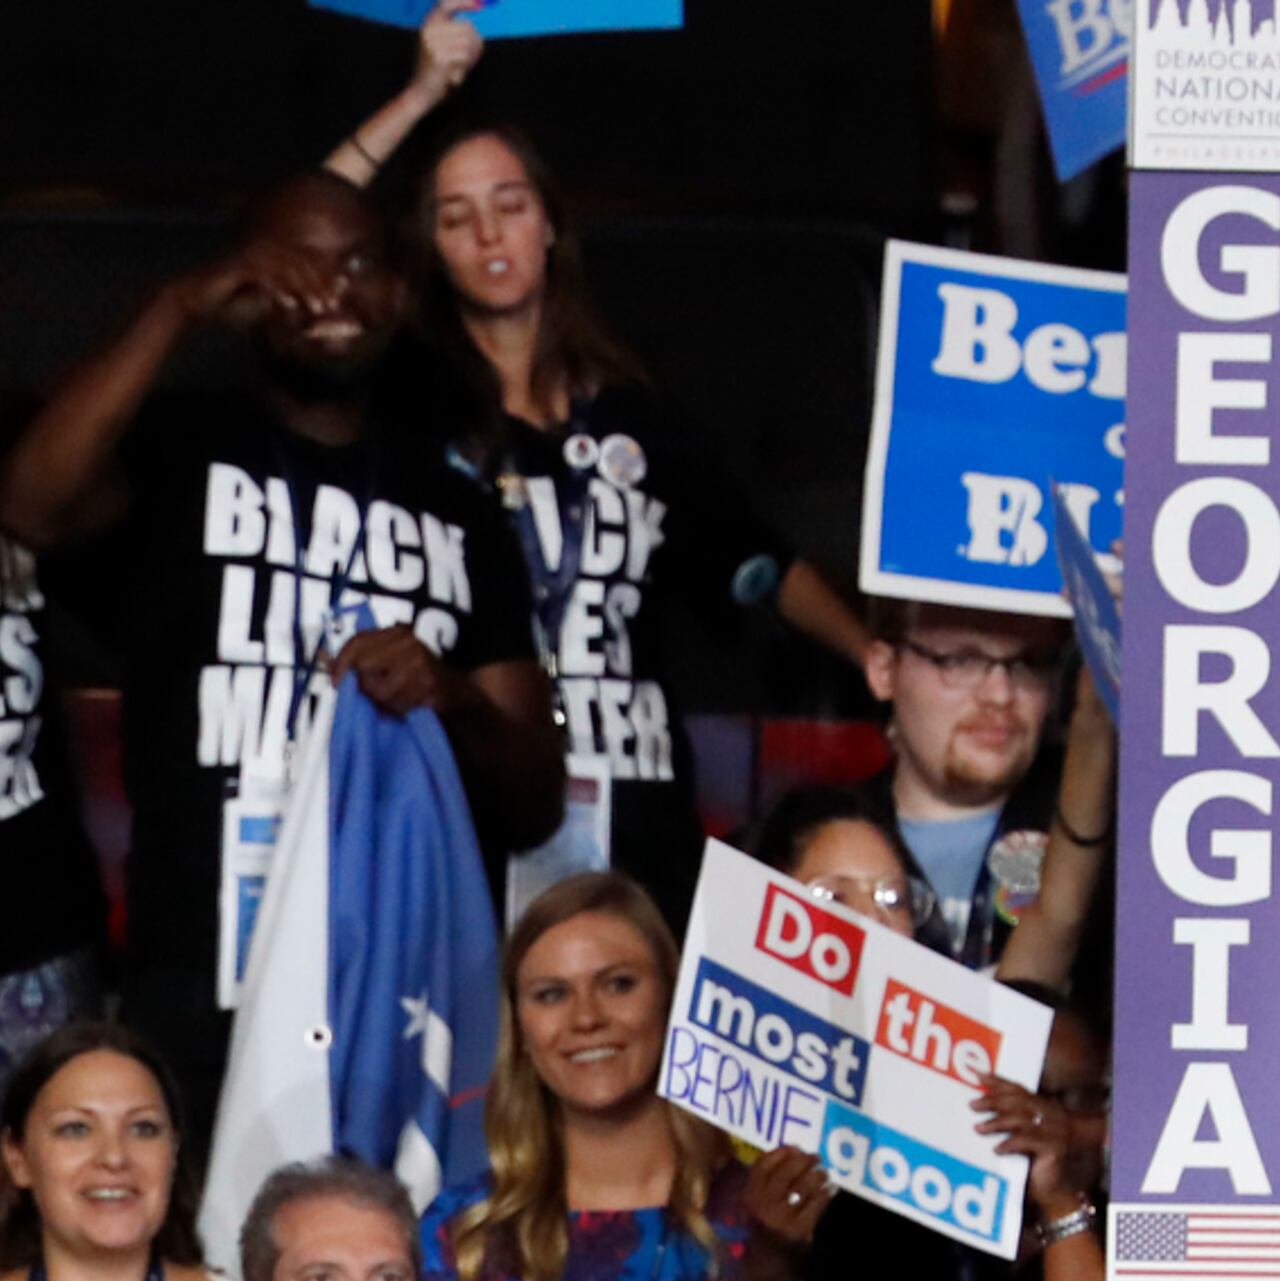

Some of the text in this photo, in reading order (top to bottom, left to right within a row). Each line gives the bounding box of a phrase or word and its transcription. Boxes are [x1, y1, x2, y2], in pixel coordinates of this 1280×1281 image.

[763, 890, 852, 984] Do
[665, 1027, 825, 1148] BERNIE
[695, 979, 861, 1097] most
[886, 990, 992, 1084] the
[825, 1125, 1003, 1238] good
